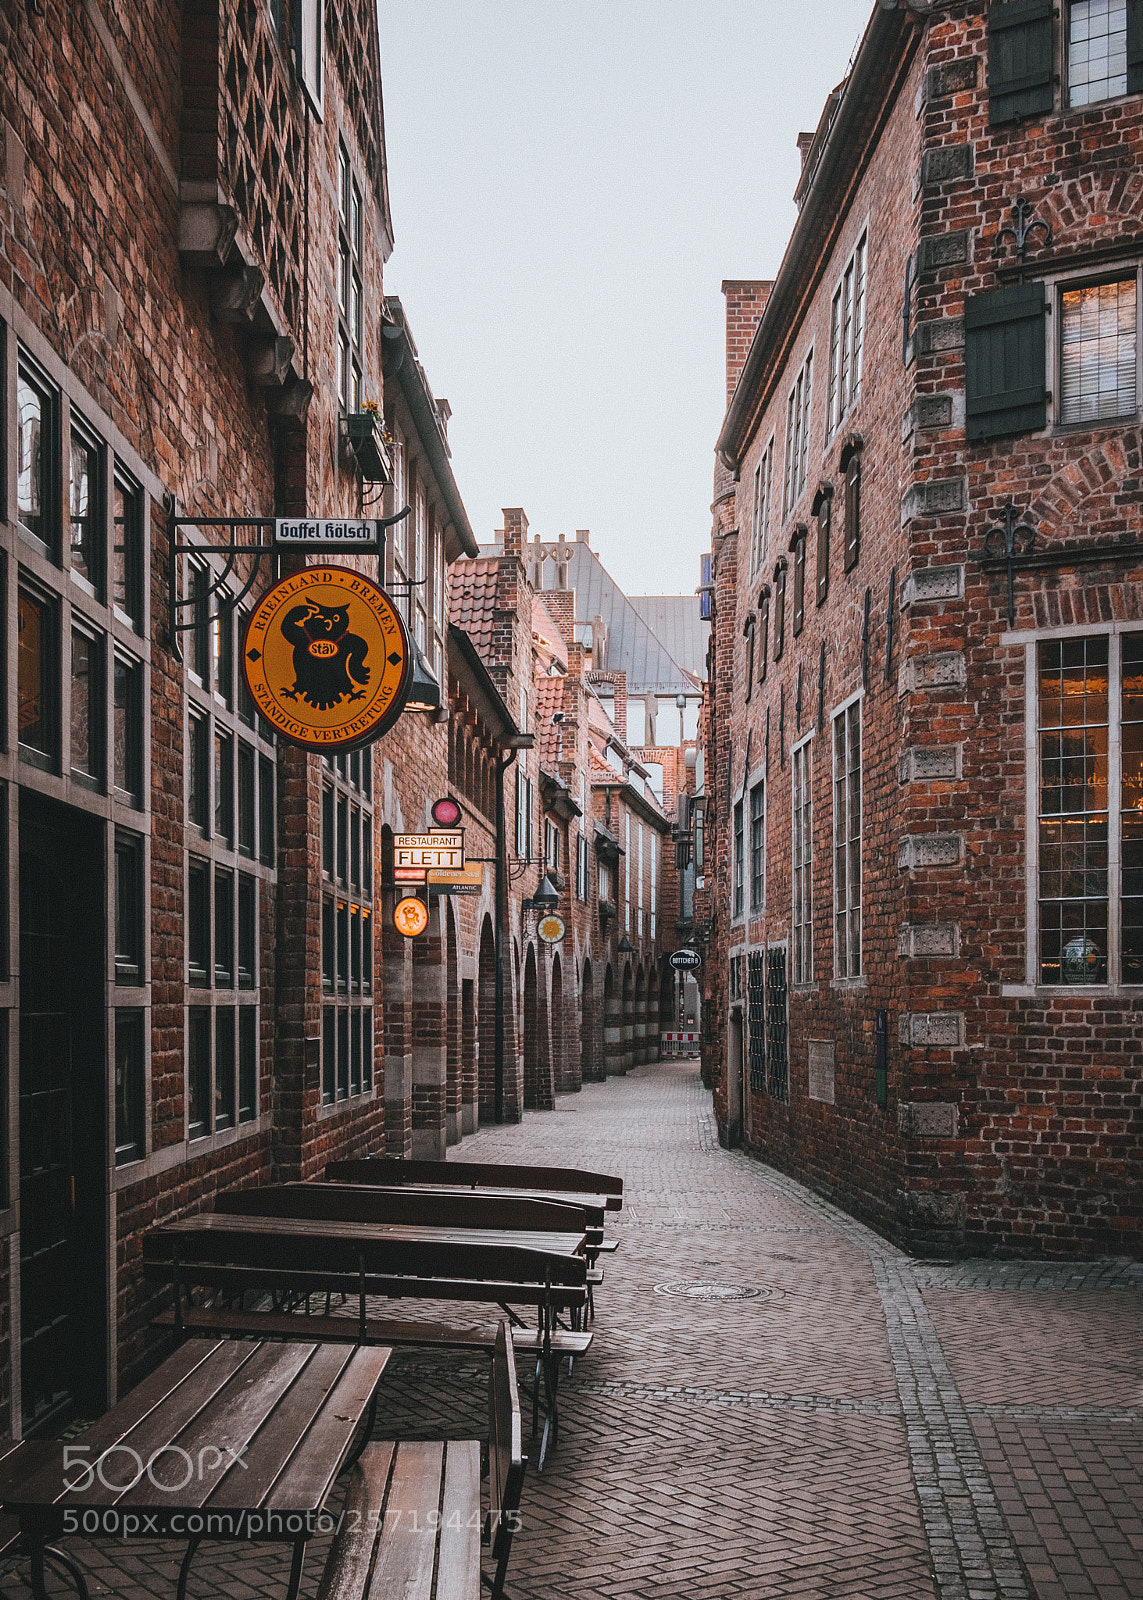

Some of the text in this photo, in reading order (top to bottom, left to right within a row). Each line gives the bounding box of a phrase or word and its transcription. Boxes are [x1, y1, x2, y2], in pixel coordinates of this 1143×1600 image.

[280, 522, 371, 540] Gaffel Kölsch
[254, 572, 398, 636] RHEINLAND BREMEN
[254, 683, 393, 741] STÄNDIGE VERTRETUNG
[398, 836, 457, 846] RESTAURANT
[398, 851, 457, 865] FLETT
